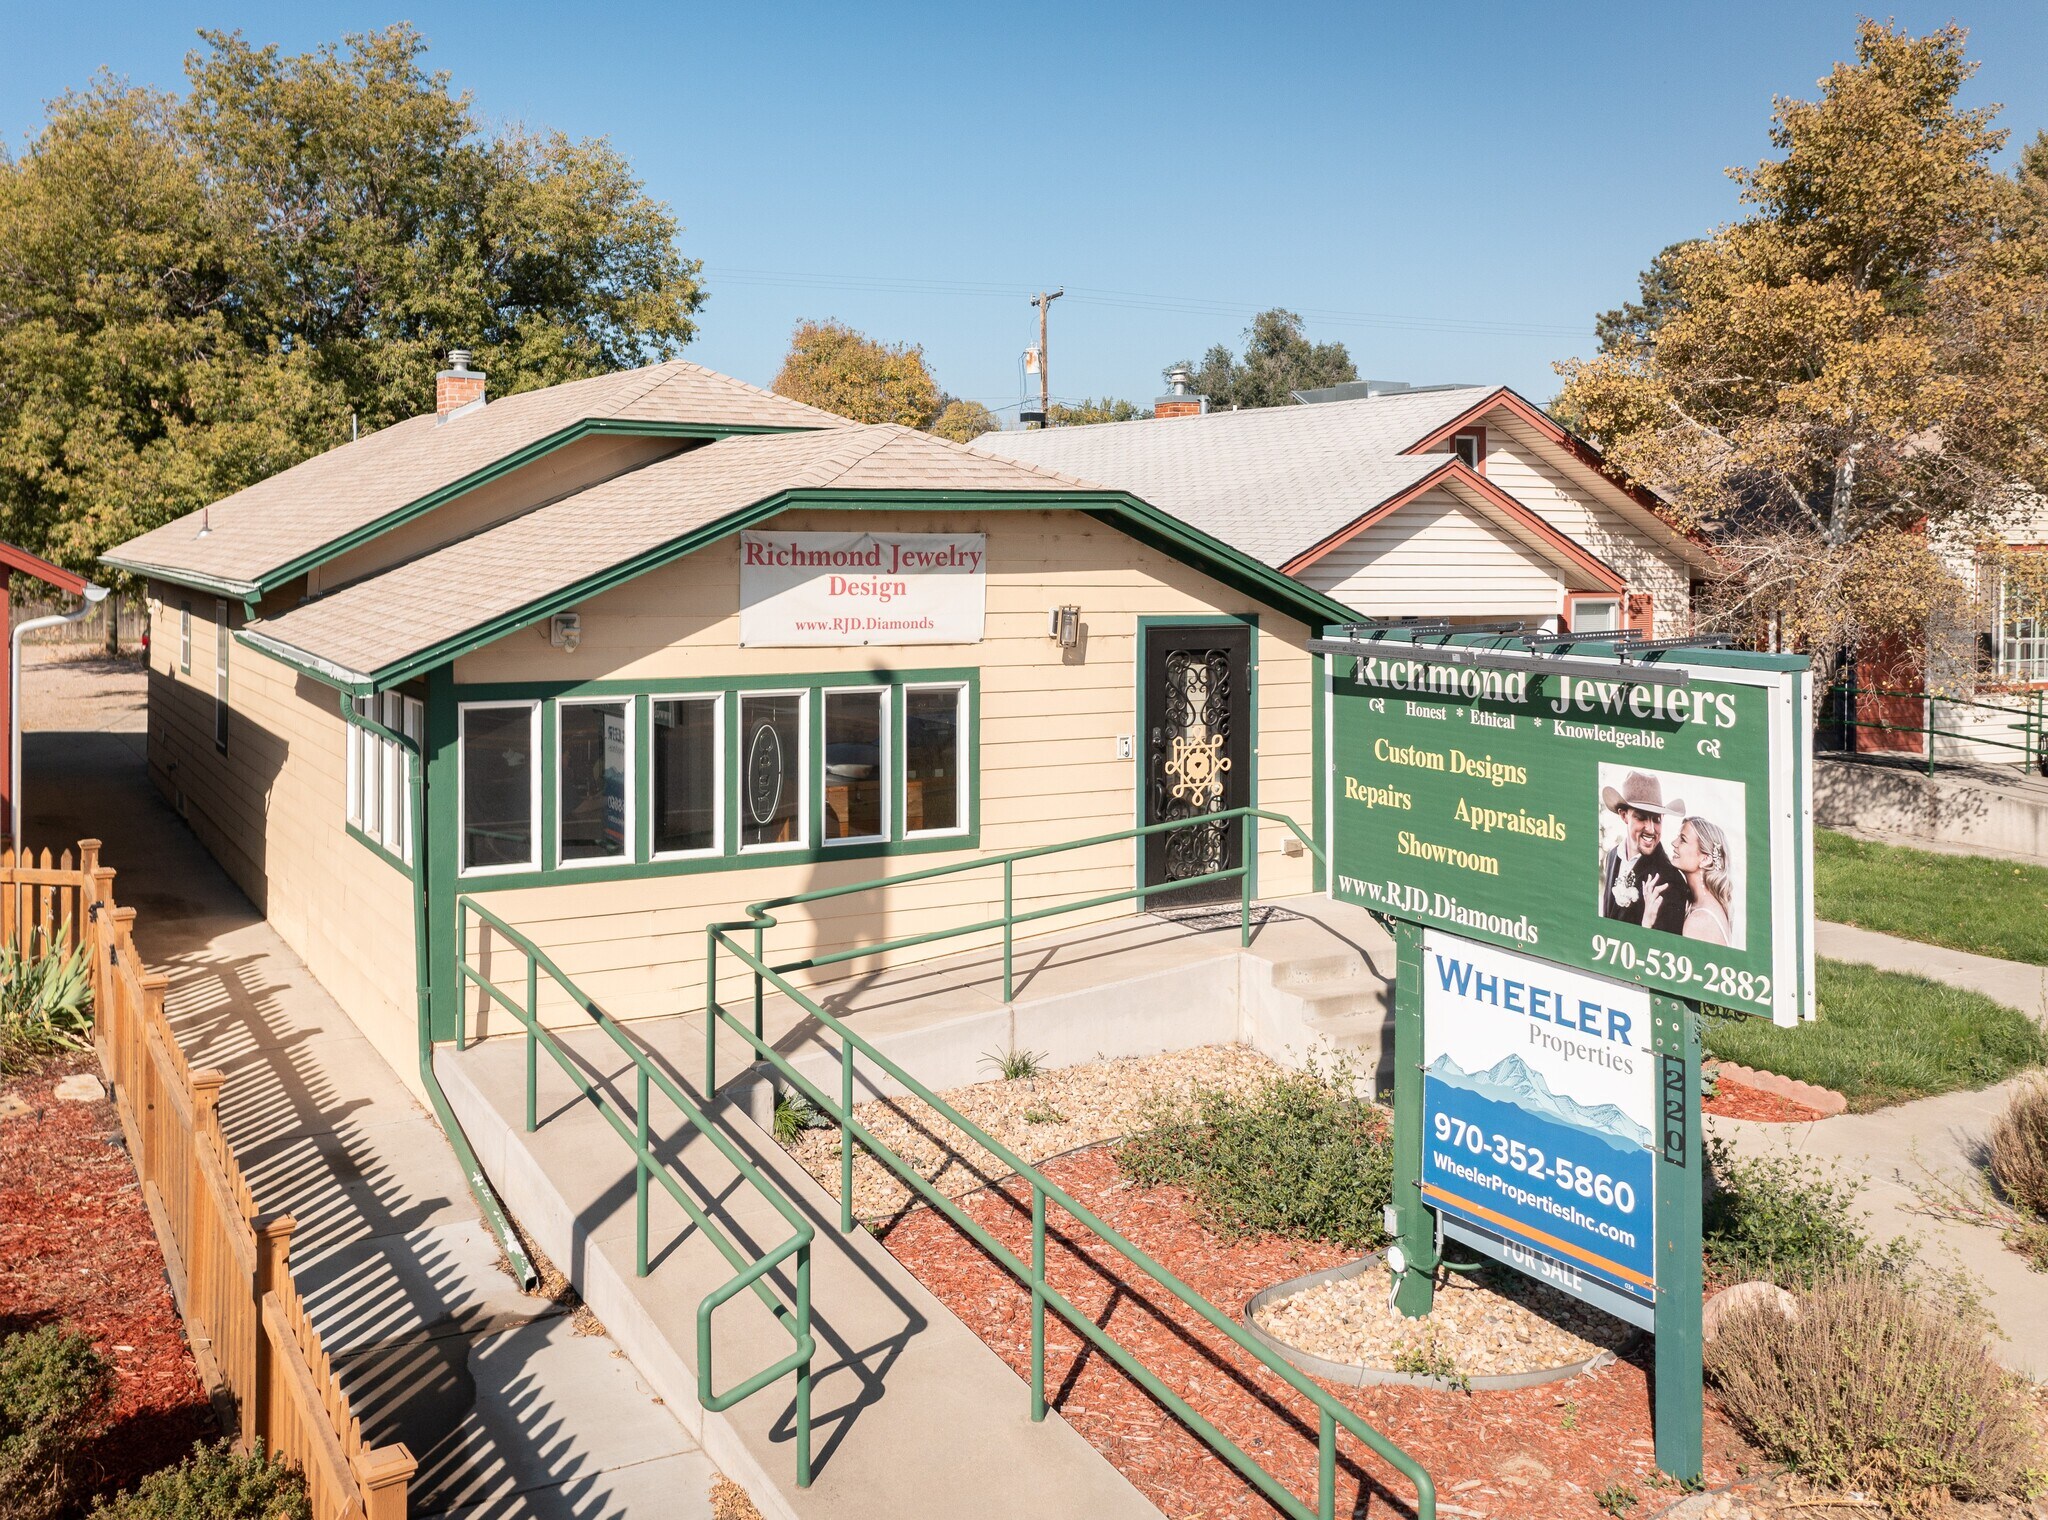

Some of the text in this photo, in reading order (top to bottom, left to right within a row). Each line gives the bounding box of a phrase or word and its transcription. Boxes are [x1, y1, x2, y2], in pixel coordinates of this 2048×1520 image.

[745, 542, 982, 574] Richmond Jewelry
[828, 575, 907, 602] Design
[795, 616, 934, 634] www.RJD.Diamonds
[1355, 657, 1736, 728] Richmond Jewelers
[1405, 701, 1664, 749] Honest Ethical Knowledgeable
[1374, 738, 1527, 786] Custom Designs
[1344, 776, 1566, 841] Repairs Appraisals
[1397, 831, 1499, 875] Showroom
[1338, 875, 1538, 944] www.RJD.Diamonds
[1592, 934, 1772, 1006] 970-539-2882
[1436, 955, 1632, 1046] WHEELER
[1529, 1023, 1634, 1075] Properties
[1666, 1070, 1683, 1151] 220
[1434, 1112, 1635, 1214] 970-352-5860
[1433, 1150, 1635, 1248] WheelerPropertiesInc.com
[1541, 1253, 1582, 1292] SALE
